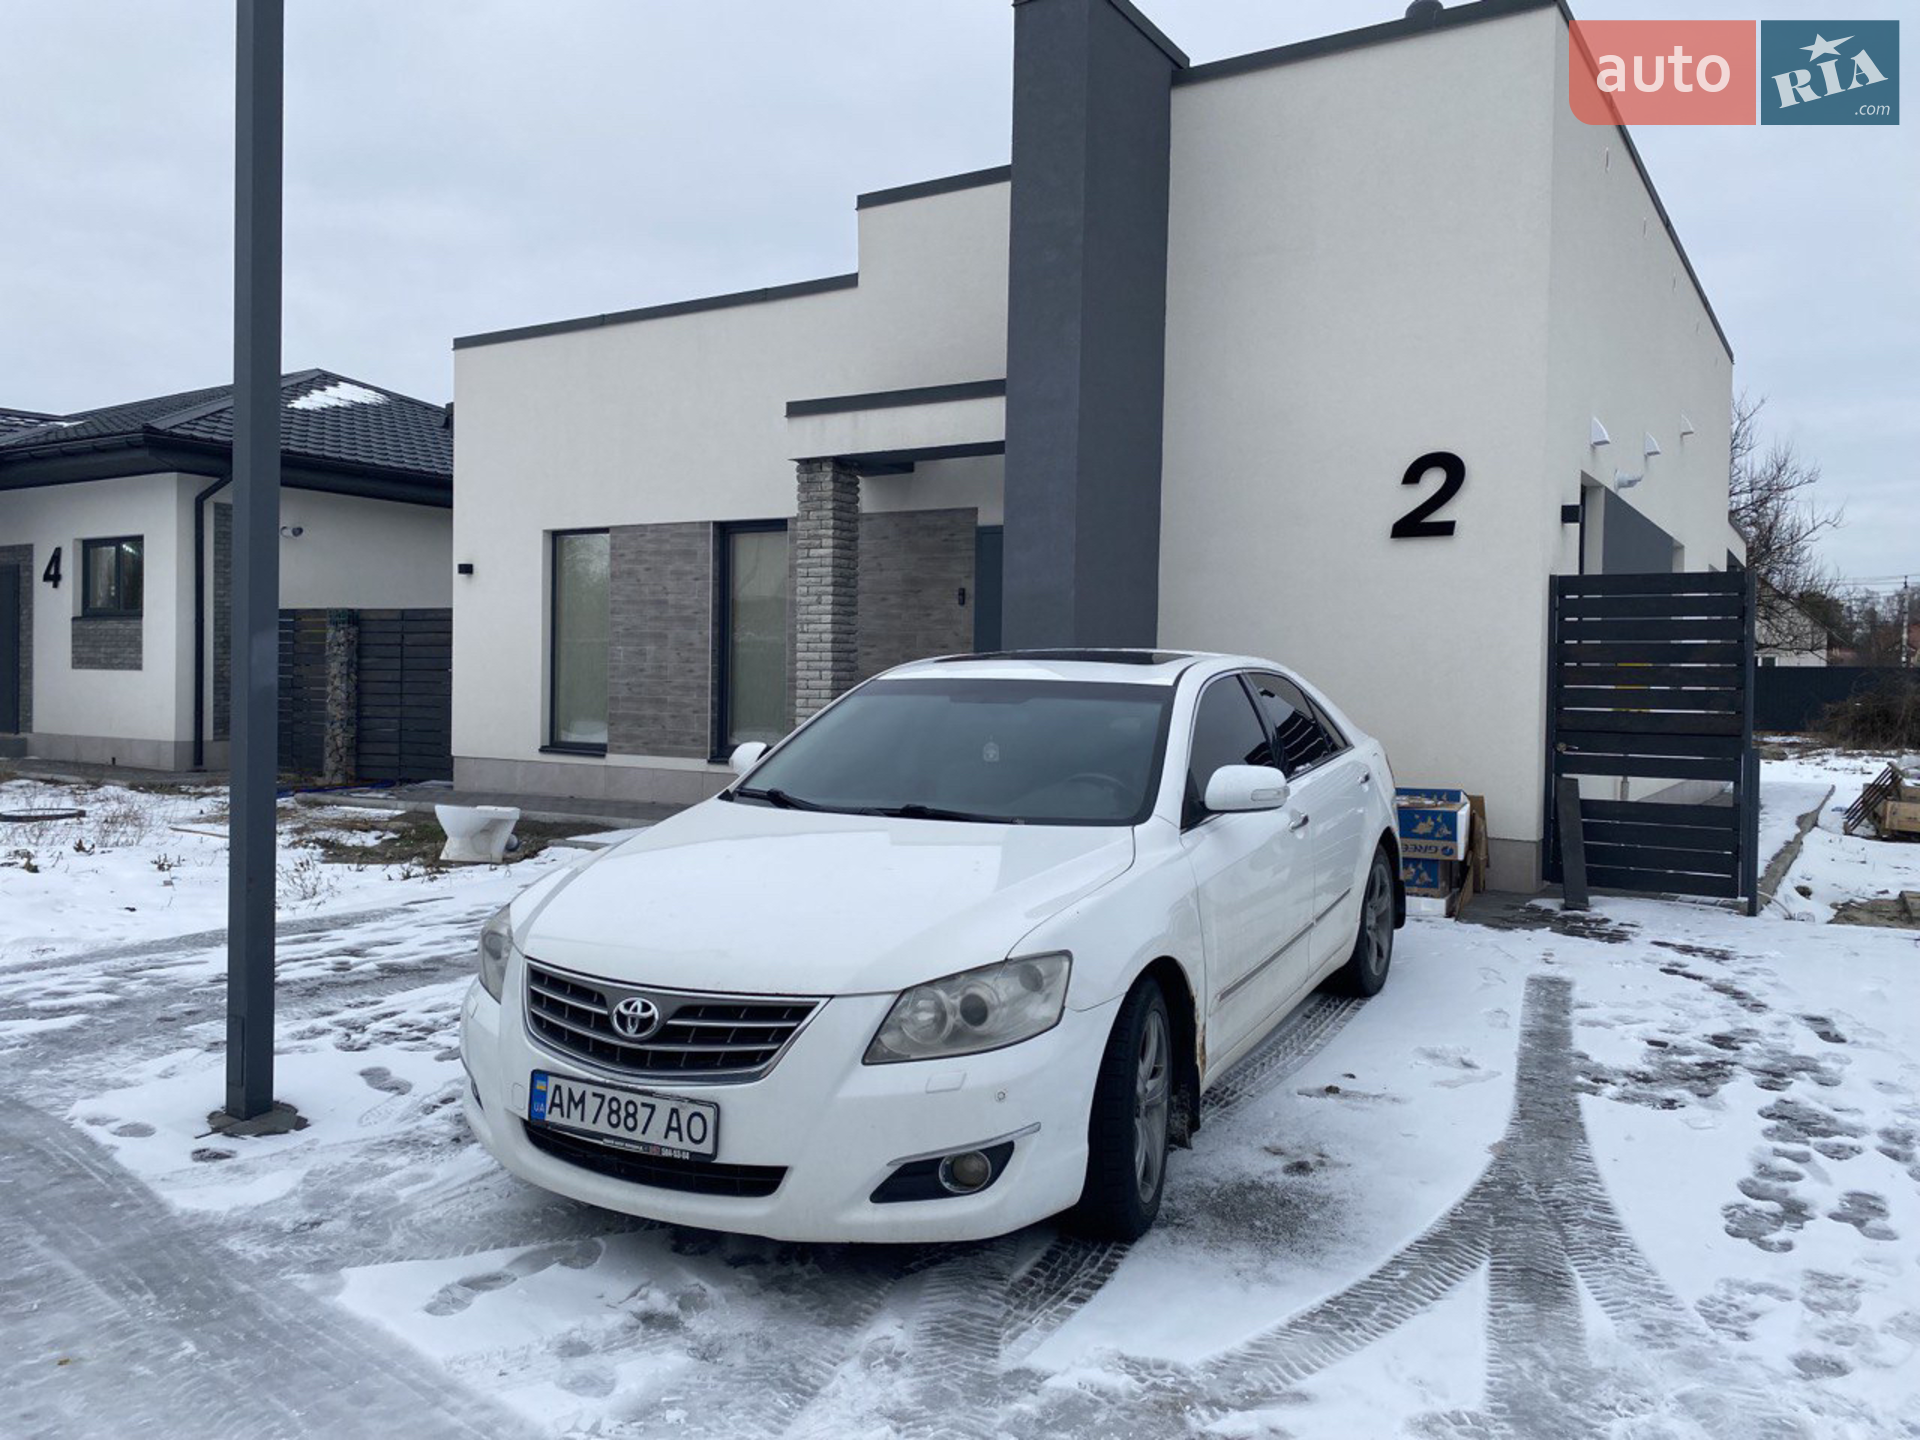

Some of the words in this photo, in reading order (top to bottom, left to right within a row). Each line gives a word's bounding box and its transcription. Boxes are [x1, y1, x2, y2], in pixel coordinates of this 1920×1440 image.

[1390, 451, 1466, 539] 2
[42, 546, 62, 589] 4
[533, 1101, 546, 1114] UA
[548, 1084, 586, 1123] AM
[591, 1092, 656, 1136] 7887
[663, 1107, 708, 1146] AO
